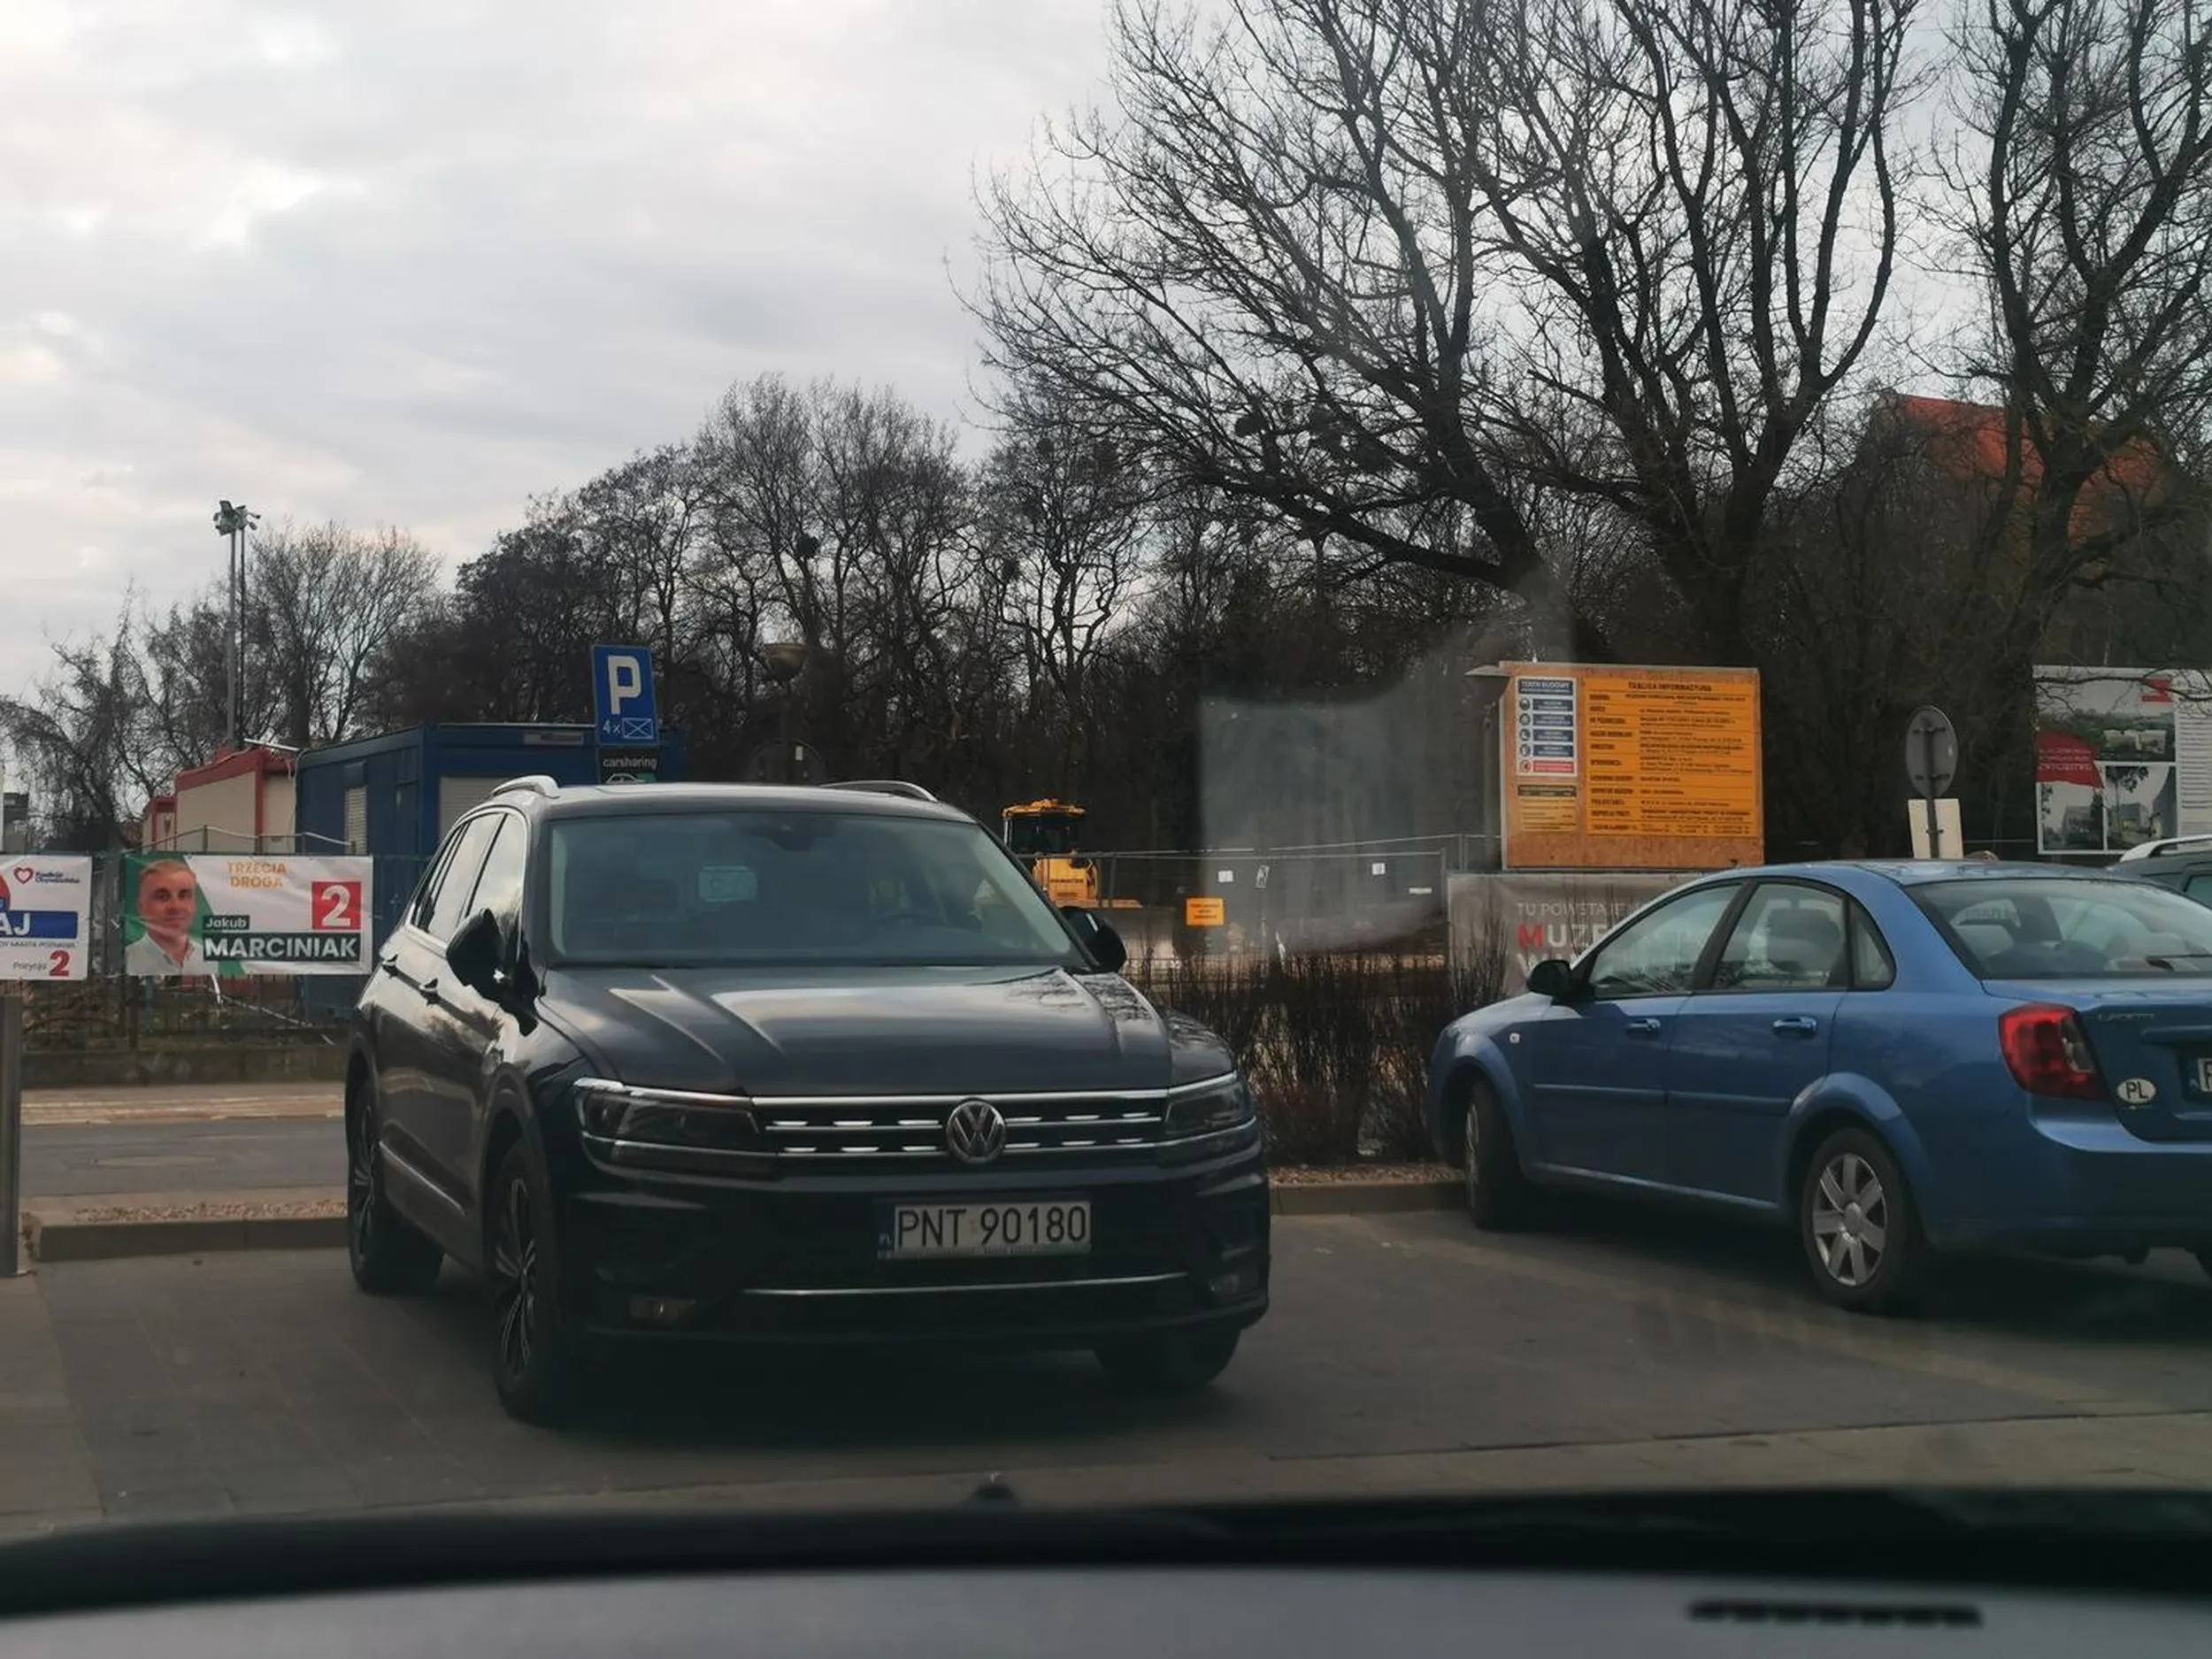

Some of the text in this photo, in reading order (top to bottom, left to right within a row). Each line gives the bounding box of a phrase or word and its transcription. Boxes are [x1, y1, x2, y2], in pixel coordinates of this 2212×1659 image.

[608, 655, 641, 715] P
[603, 756, 658, 771] carsharing
[227, 861, 288, 875] TRZECIA
[230, 876, 283, 888] DROGA
[320, 885, 351, 927] 2
[205, 916, 248, 928] Jakub
[204, 936, 357, 958] MARCINIAK
[49, 949, 70, 977] 2
[2125, 1081, 2149, 1099] PL
[898, 1205, 1087, 1247] PNT 90180
